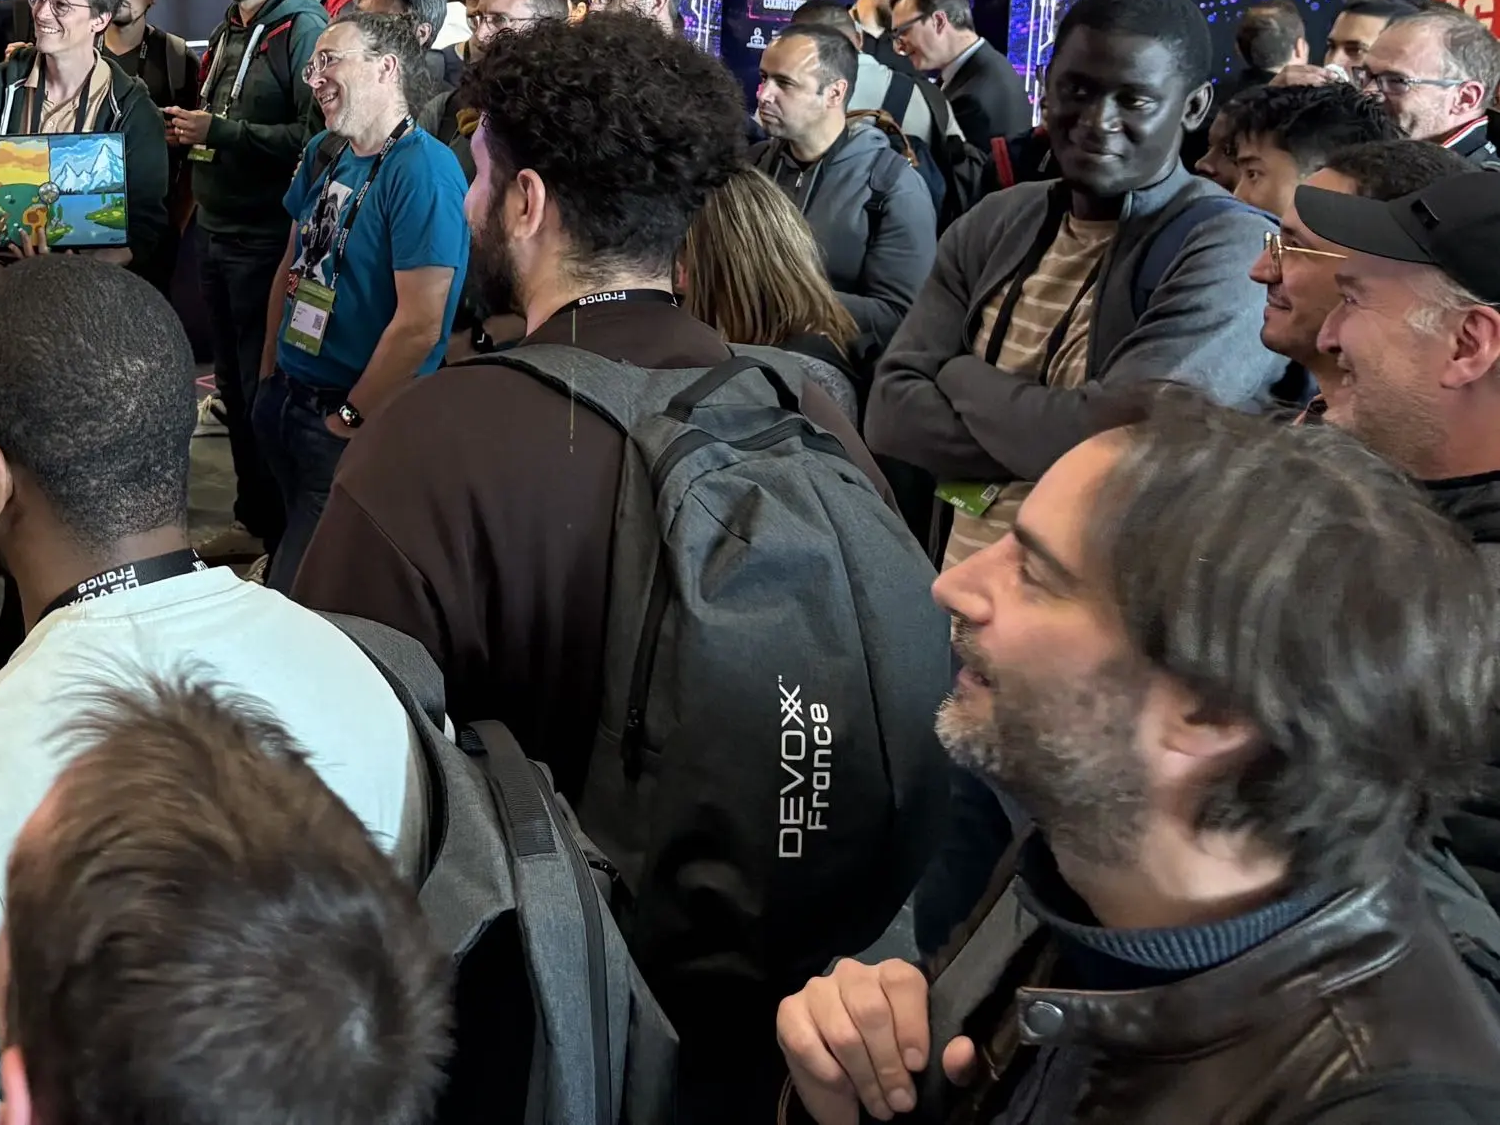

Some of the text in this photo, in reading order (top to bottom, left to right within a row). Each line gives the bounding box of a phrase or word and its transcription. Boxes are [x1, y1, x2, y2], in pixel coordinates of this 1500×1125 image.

[579, 291, 627, 306] France
[77, 565, 136, 594] France
[807, 703, 833, 830] France
